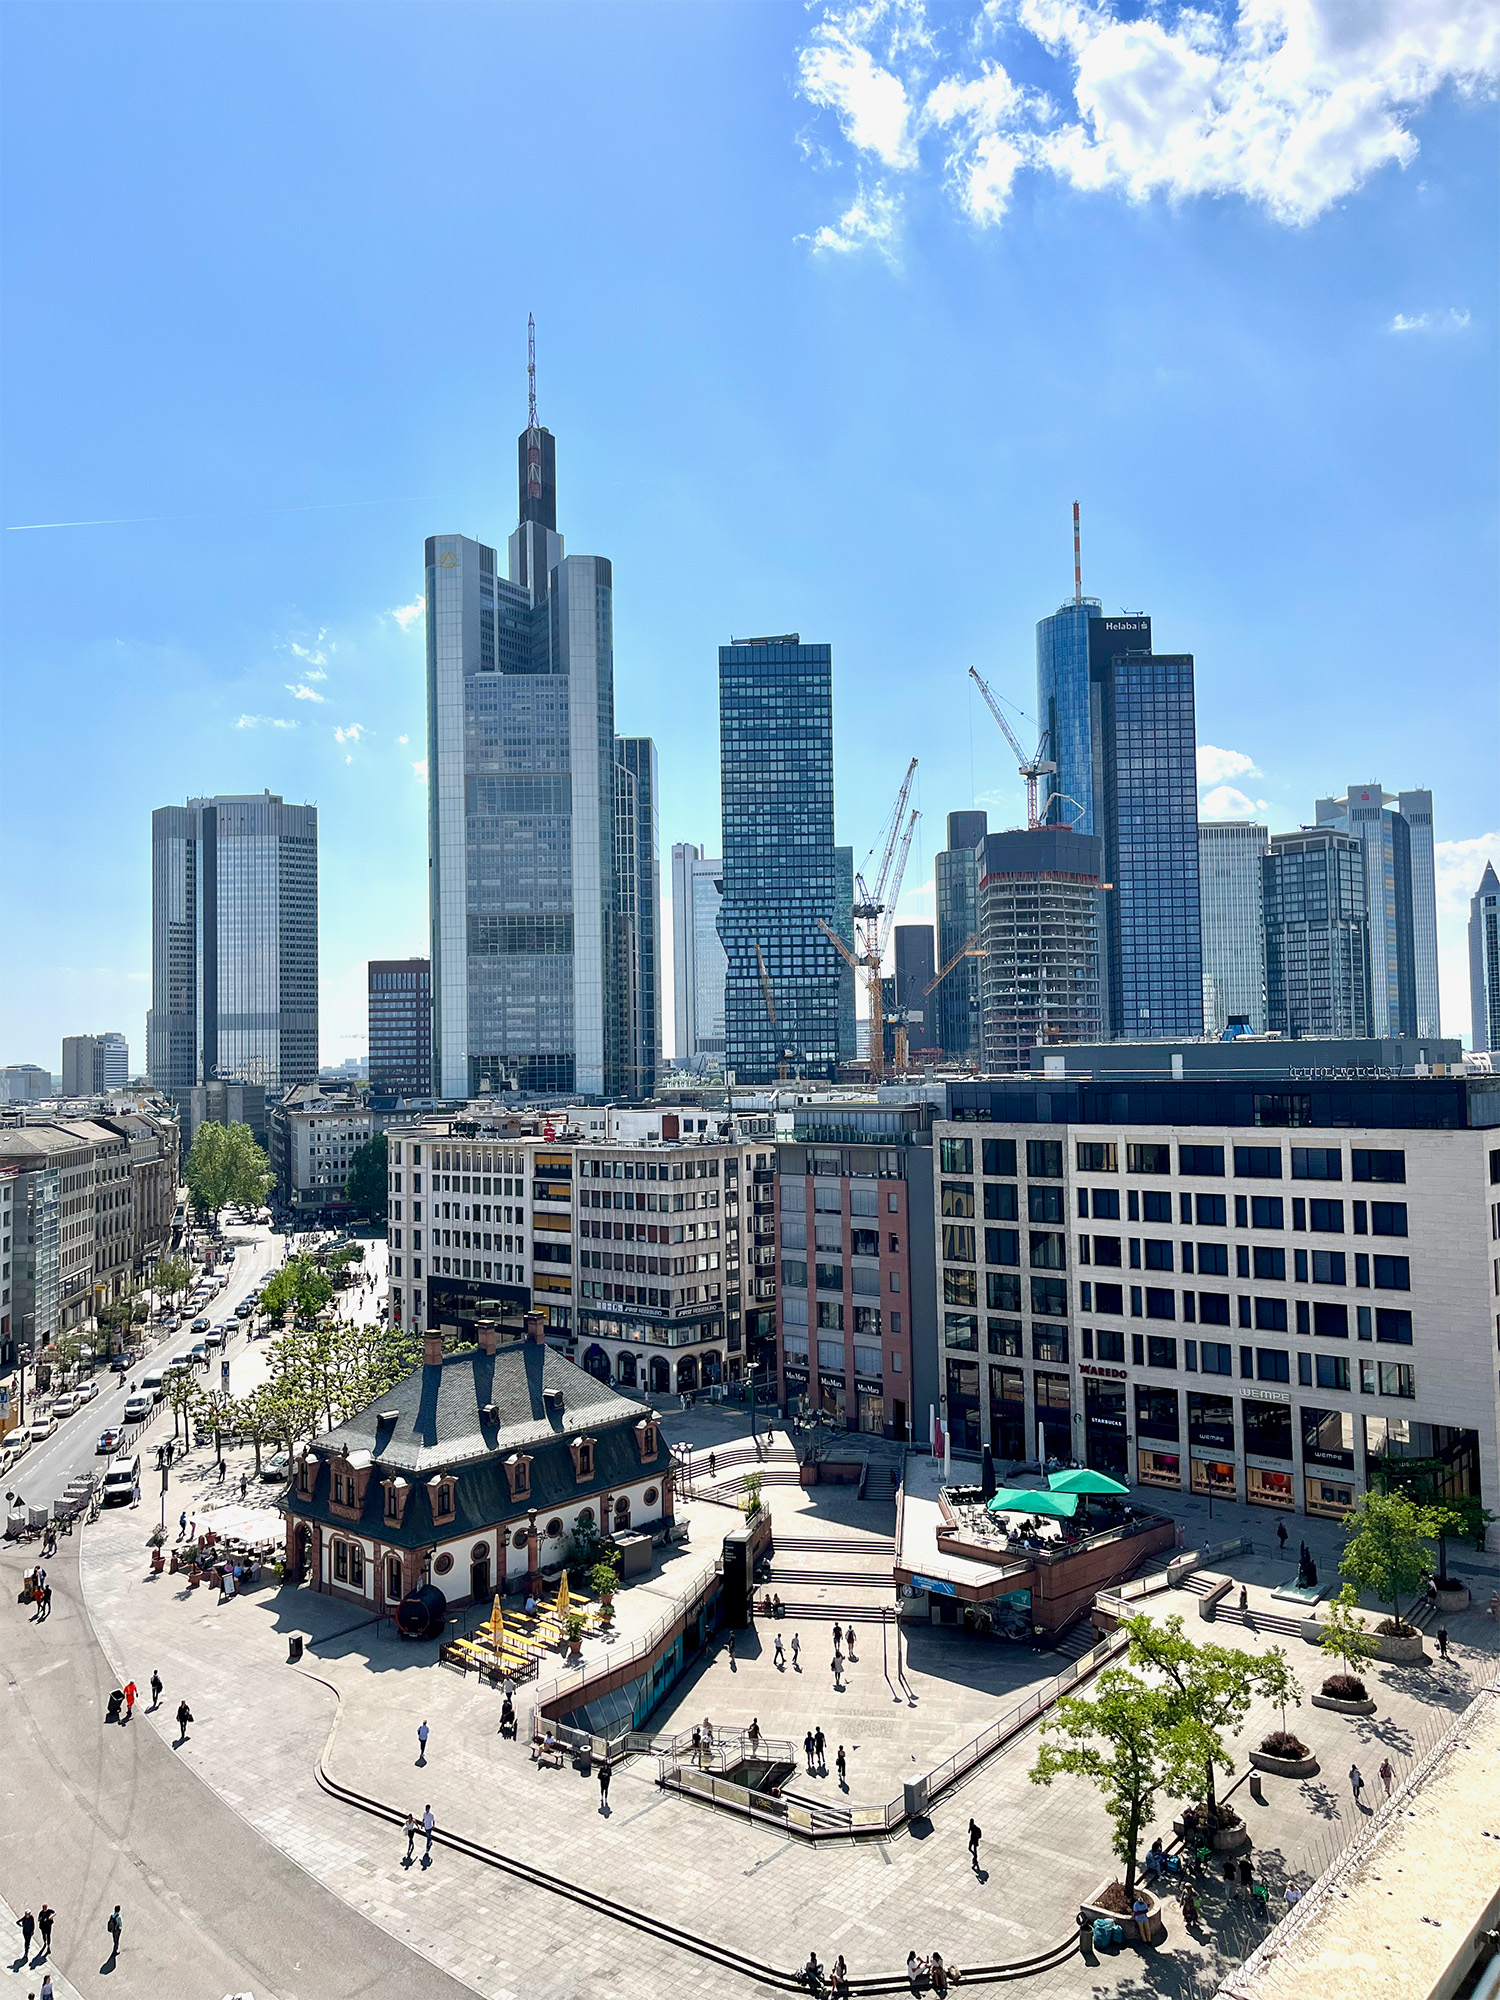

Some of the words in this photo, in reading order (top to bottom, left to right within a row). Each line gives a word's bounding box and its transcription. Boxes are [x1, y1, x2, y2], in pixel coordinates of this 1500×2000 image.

[1105, 622, 1137, 630] Helaba
[1079, 1363, 1128, 1379] MAREDO
[821, 1377, 842, 1388] MaxMara
[857, 1383, 880, 1394] MaxMara
[1239, 1387, 1291, 1402] WEMPE
[1091, 1417, 1123, 1427] STARBUCKS
[1199, 1433, 1225, 1442] WEMPE
[1314, 1451, 1343, 1461] WEMPE
